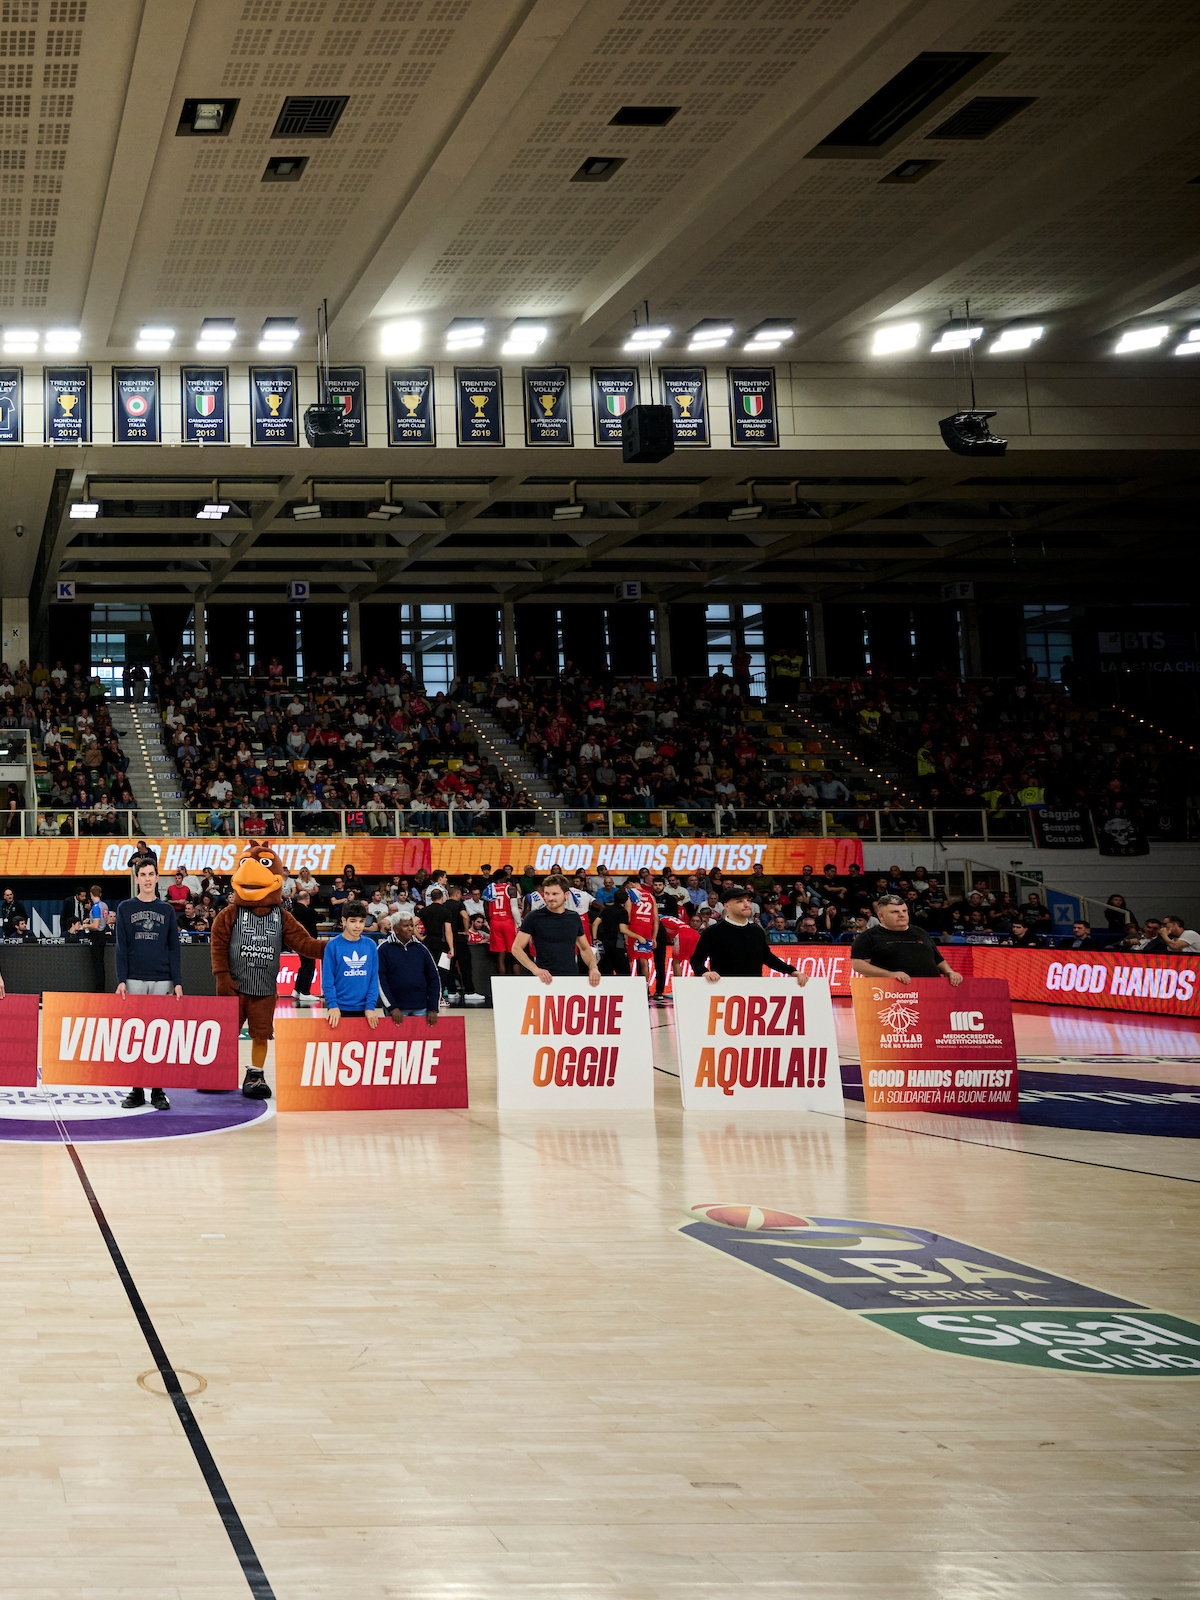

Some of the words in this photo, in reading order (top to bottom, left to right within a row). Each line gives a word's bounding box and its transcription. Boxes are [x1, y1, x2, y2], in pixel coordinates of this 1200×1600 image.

[60, 583, 73, 596] K
[294, 584, 306, 595] D
[626, 584, 637, 596] E
[1124, 631, 1166, 649] BTS
[1039, 809, 1080, 821] Gaggio
[1042, 823, 1081, 833] Sempre
[1045, 834, 1067, 843] Con
[1070, 834, 1084, 843] noi
[164, 844, 237, 871] HANDS
[534, 844, 594, 871] GOOD
[597, 844, 669, 871] HANDS
[672, 844, 768, 871] CONTEST
[636, 901, 652, 915] 22
[130, 911, 165, 924] GEORGETOWN
[134, 932, 159, 940] UNIVERSITY
[1046, 962, 1106, 995] GOOD
[1110, 965, 1196, 1000] HANDS
[520, 995, 623, 1036] ANCHE
[708, 995, 806, 1036] FORZA
[58, 1016, 221, 1065] VINCONO
[880, 1034, 922, 1044] AQUILAB
[300, 1040, 441, 1086] INSIEME
[532, 1047, 618, 1087] OGGI!
[694, 1047, 828, 1096] AQUILA!!
[869, 1070, 905, 1087] GOOD
[907, 1070, 952, 1087] HANDS
[955, 1070, 1013, 1087] CONTEST
[873, 1090, 884, 1103] LA
[887, 1088, 941, 1103] SOLIDARIETÀ
[943, 1091, 955, 1102] HA
[958, 1090, 987, 1103] BUONE
[988, 1090, 1012, 1102] MANI.
[773, 1257, 1052, 1284] LBA
[889, 1290, 1003, 1300] SERIE
[1007, 1290, 1049, 1300] A
[916, 1314, 1200, 1346] Sisal
[1047, 1348, 1200, 1369] Club
